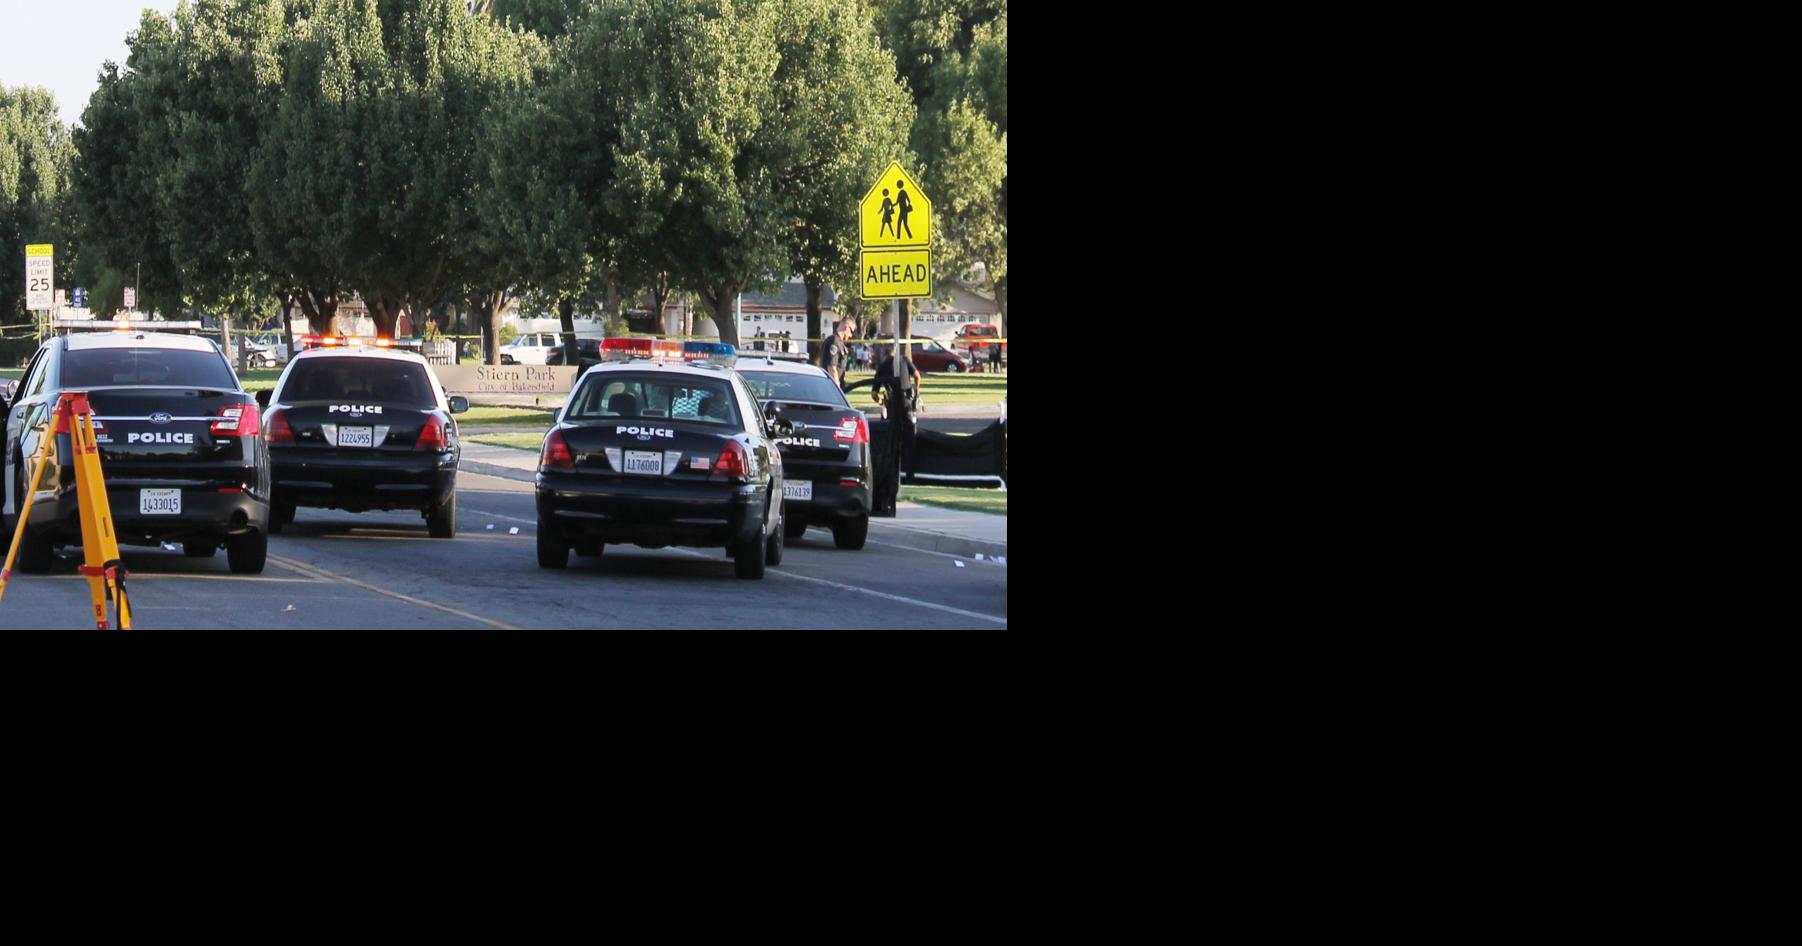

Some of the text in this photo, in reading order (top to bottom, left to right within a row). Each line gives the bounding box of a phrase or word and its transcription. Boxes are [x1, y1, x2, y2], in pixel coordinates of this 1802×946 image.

[866, 263, 926, 283] AHEAD
[30, 278, 50, 291] 25
[476, 366, 555, 380] Stiern Park
[329, 404, 383, 414] POLICE
[128, 432, 194, 443] POLICE
[616, 426, 673, 438] POLICE
[627, 458, 660, 471] 1176008
[143, 498, 179, 510] 1433015
